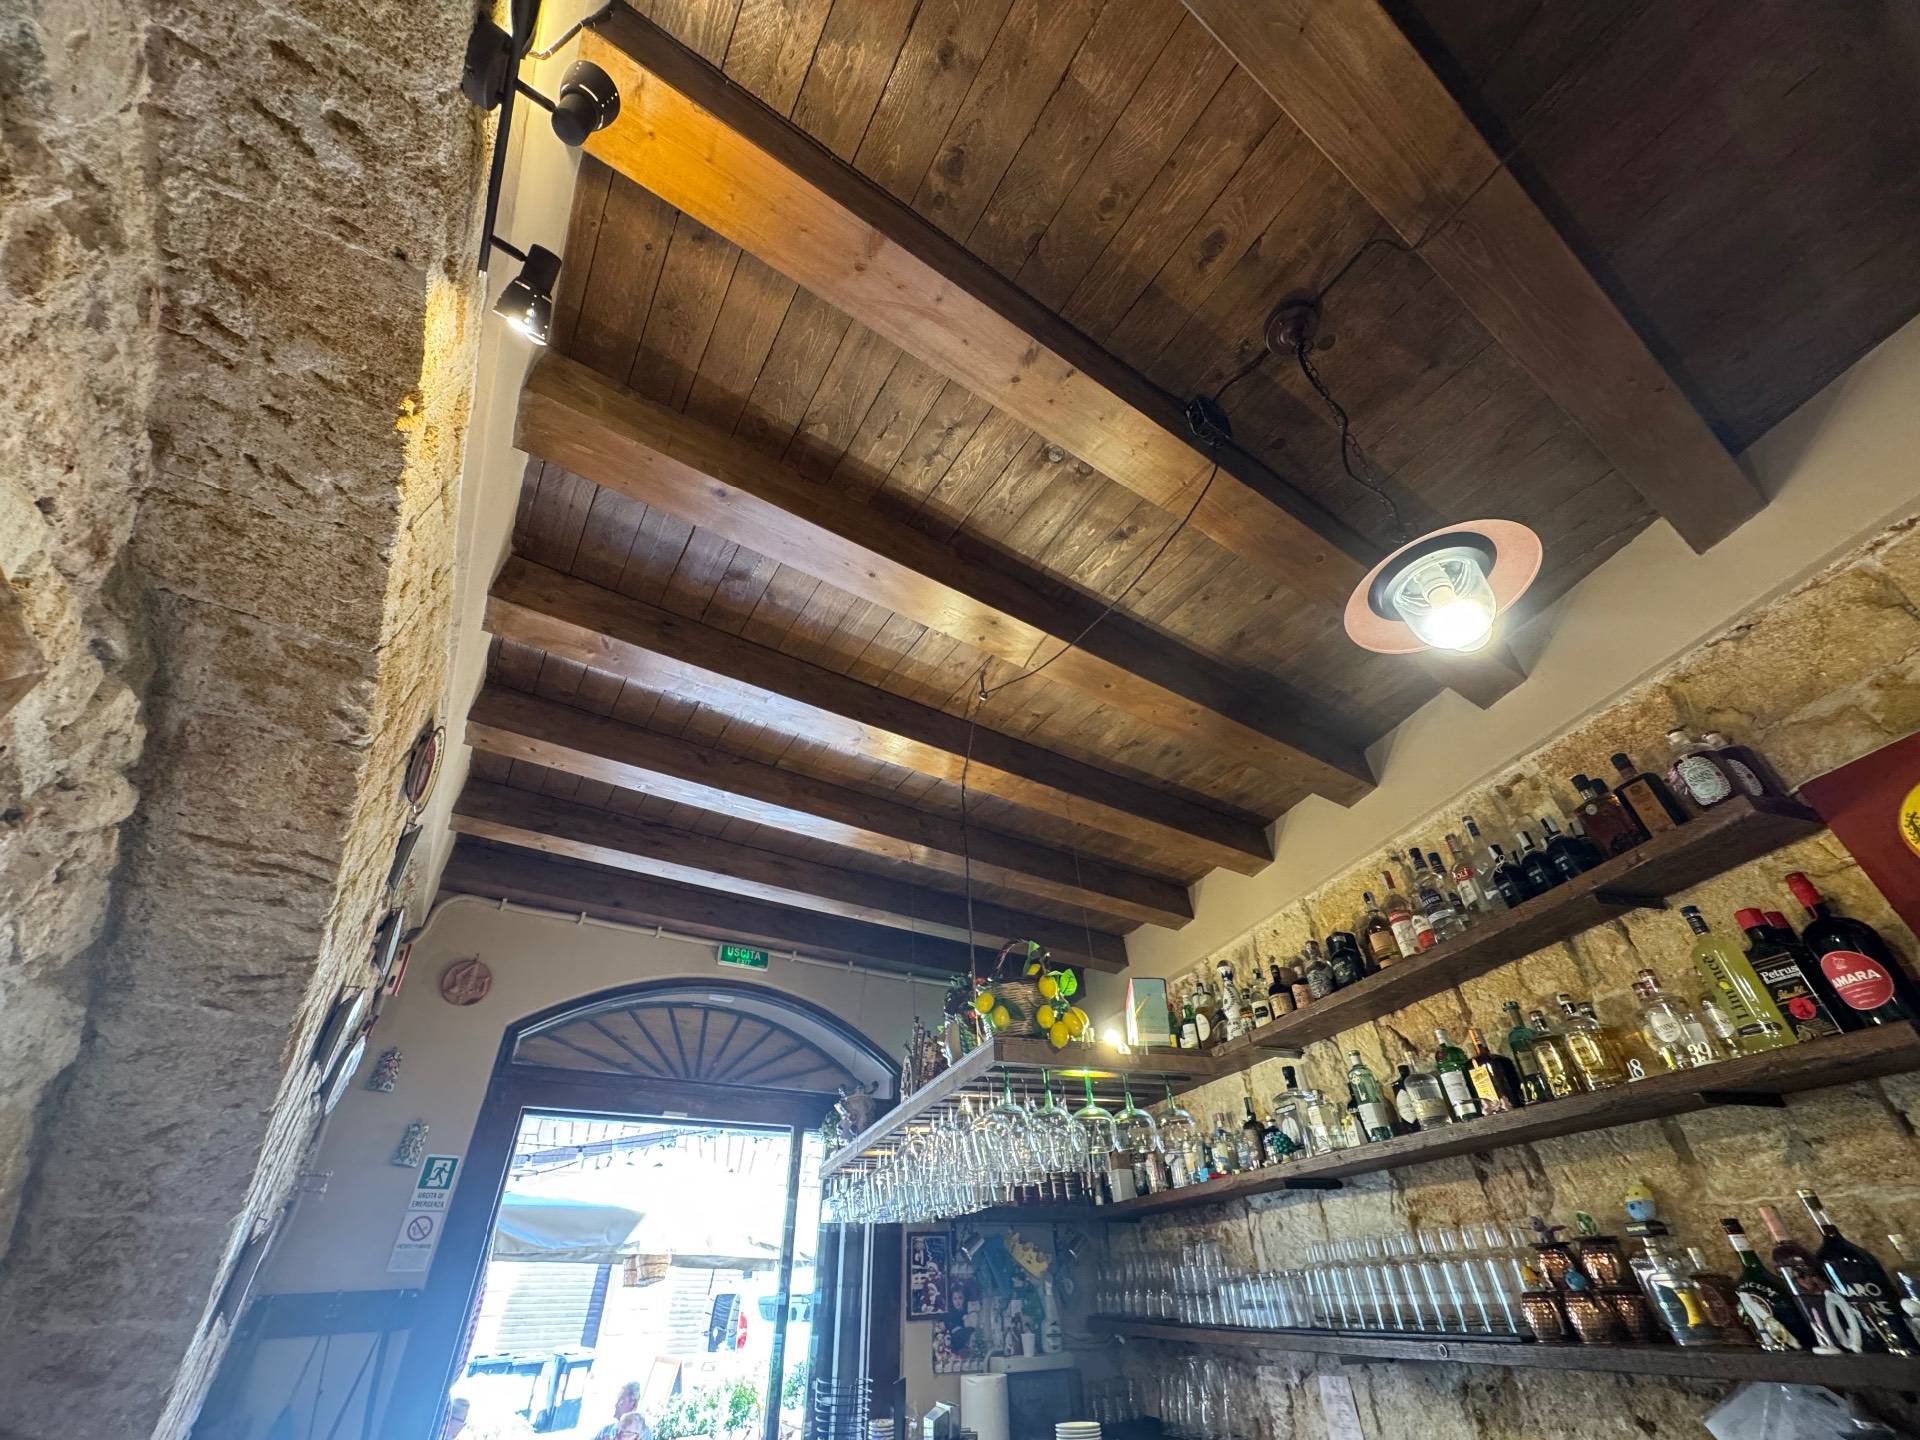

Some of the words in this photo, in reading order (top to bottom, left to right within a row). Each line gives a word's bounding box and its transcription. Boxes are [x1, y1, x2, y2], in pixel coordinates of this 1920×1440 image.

[727, 946, 761, 960] USCITA
[1760, 964, 1800, 982] Petrus
[1687, 1042, 1712, 1065] 39
[1626, 1058, 1645, 1080] 18
[1736, 1282, 1777, 1297] NICUM
